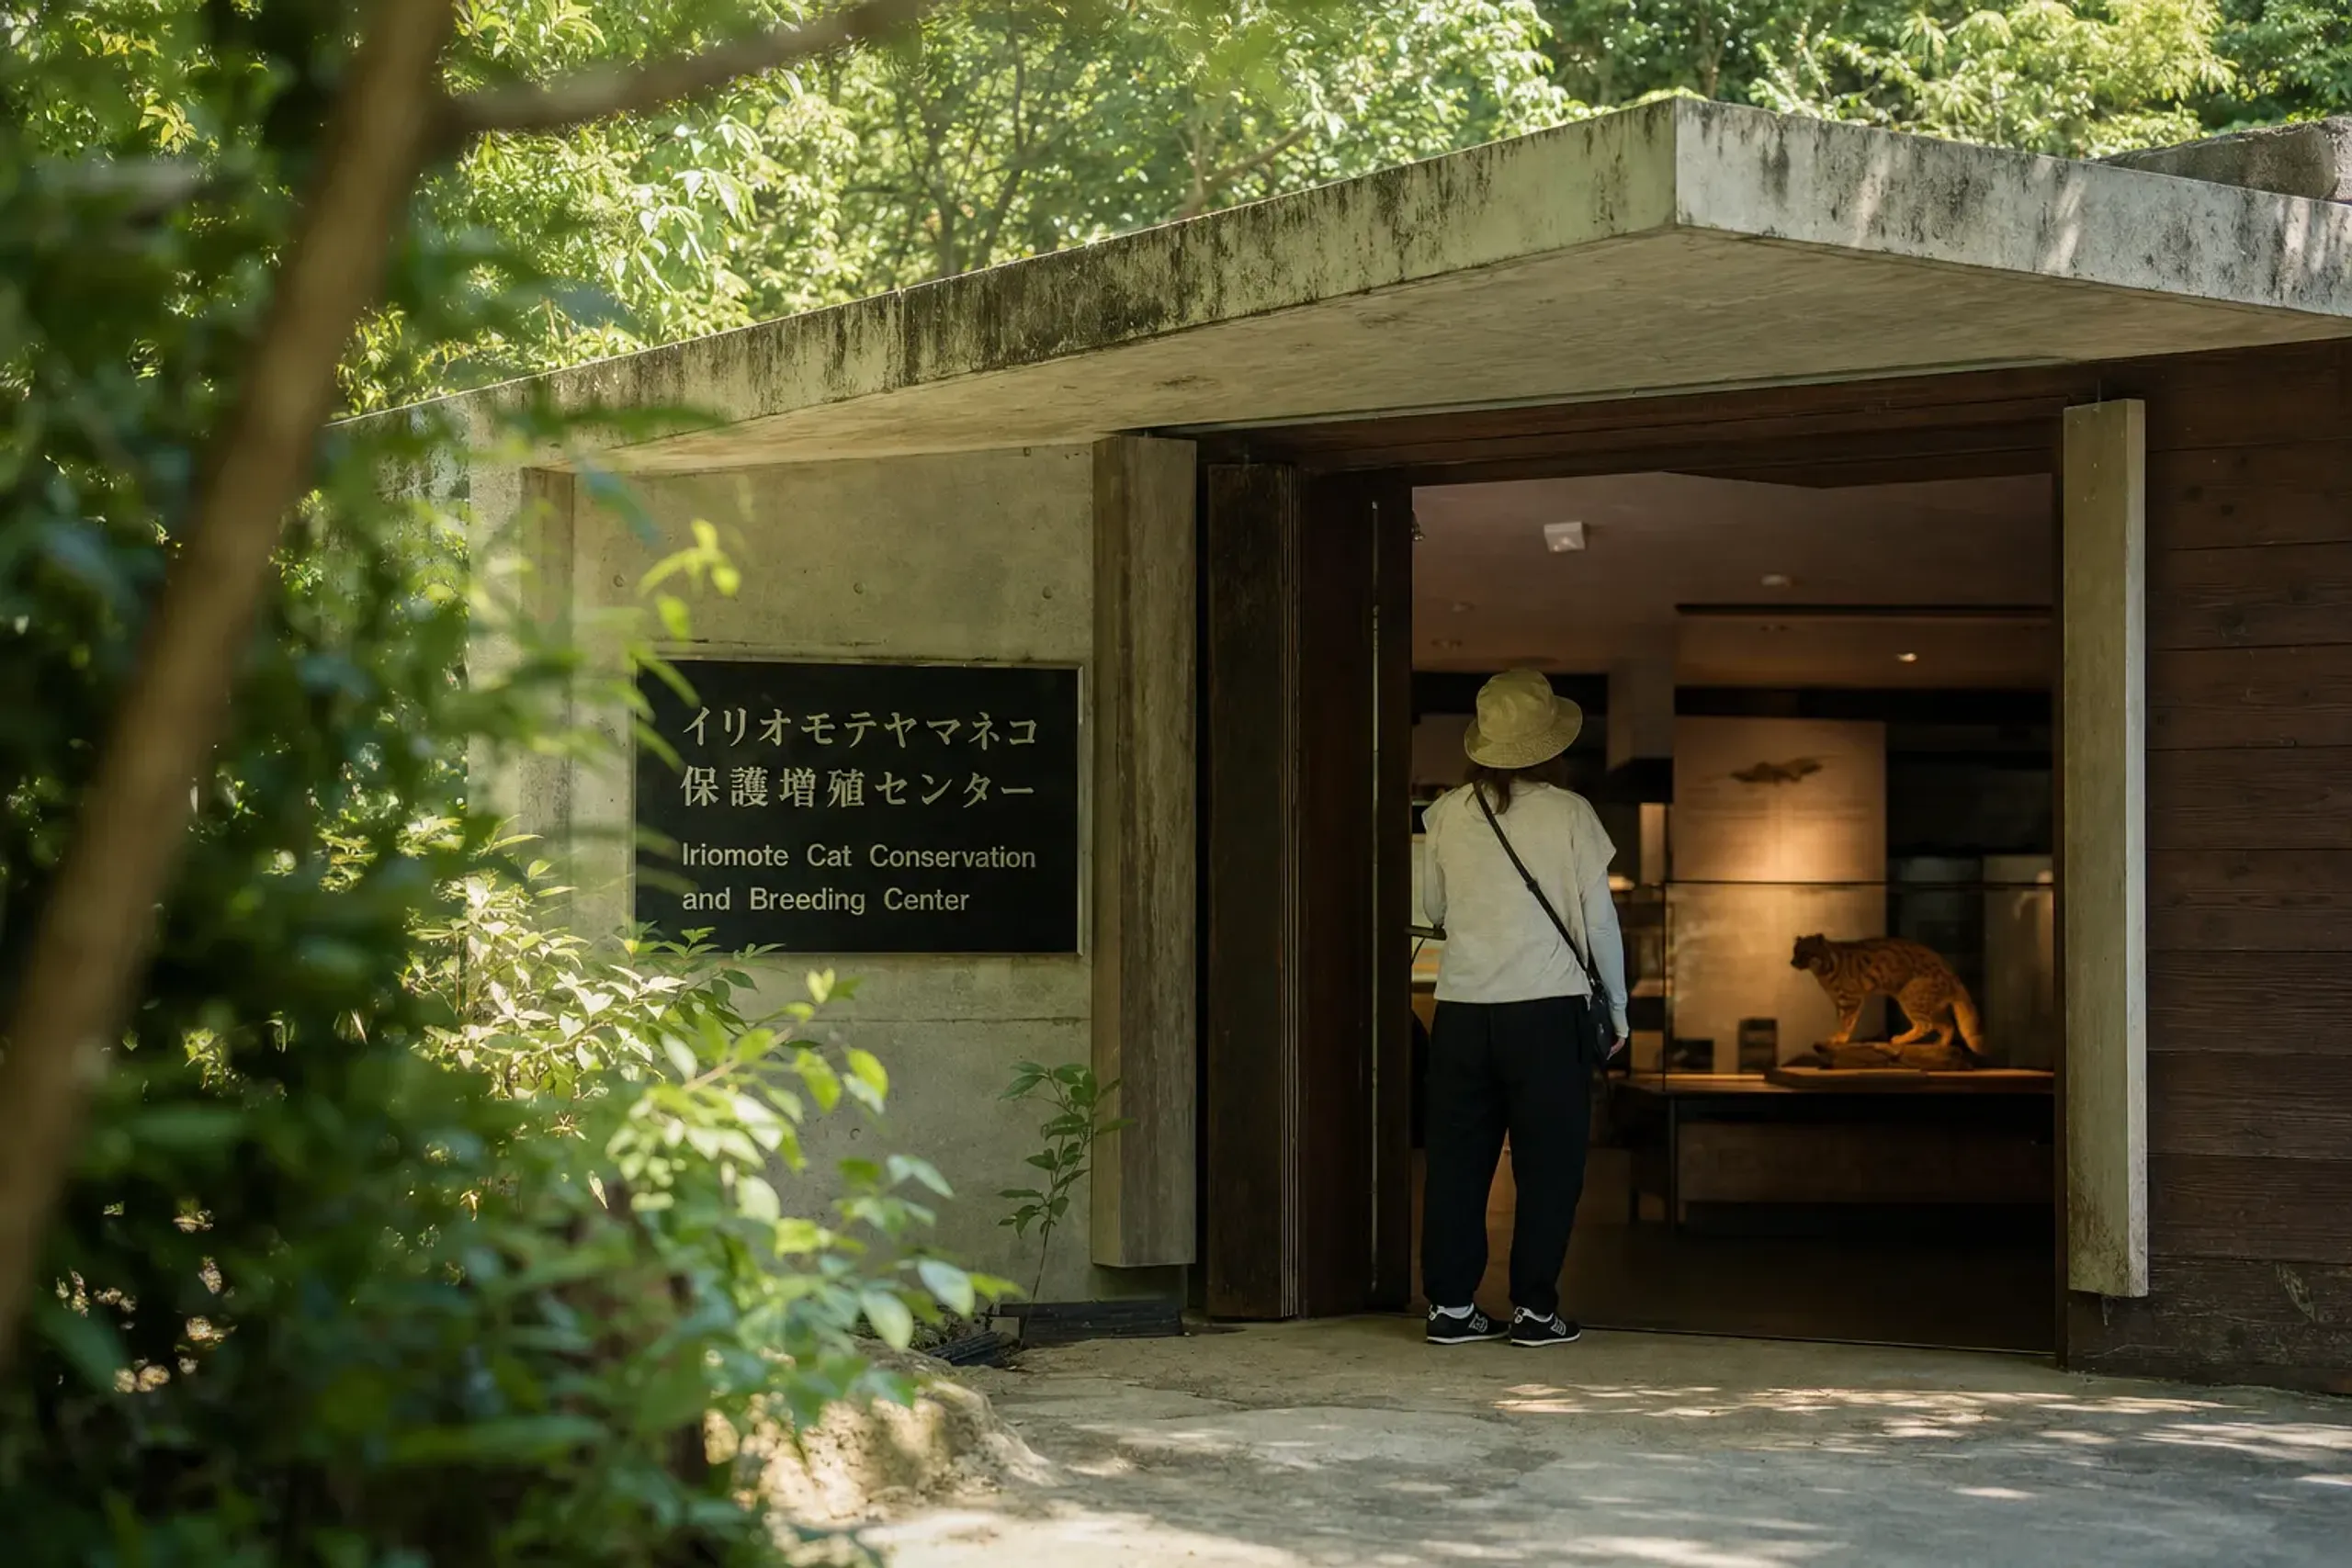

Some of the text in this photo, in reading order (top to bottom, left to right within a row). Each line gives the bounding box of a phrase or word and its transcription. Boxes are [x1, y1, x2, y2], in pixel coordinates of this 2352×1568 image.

[683, 705, 1037, 750] イリオモテヤマネコ
[680, 765, 1035, 808] 保護増殖センター
[683, 841, 1036, 868] Iriomote Cat Conservation
[682, 886, 970, 915] and Breeding Center
